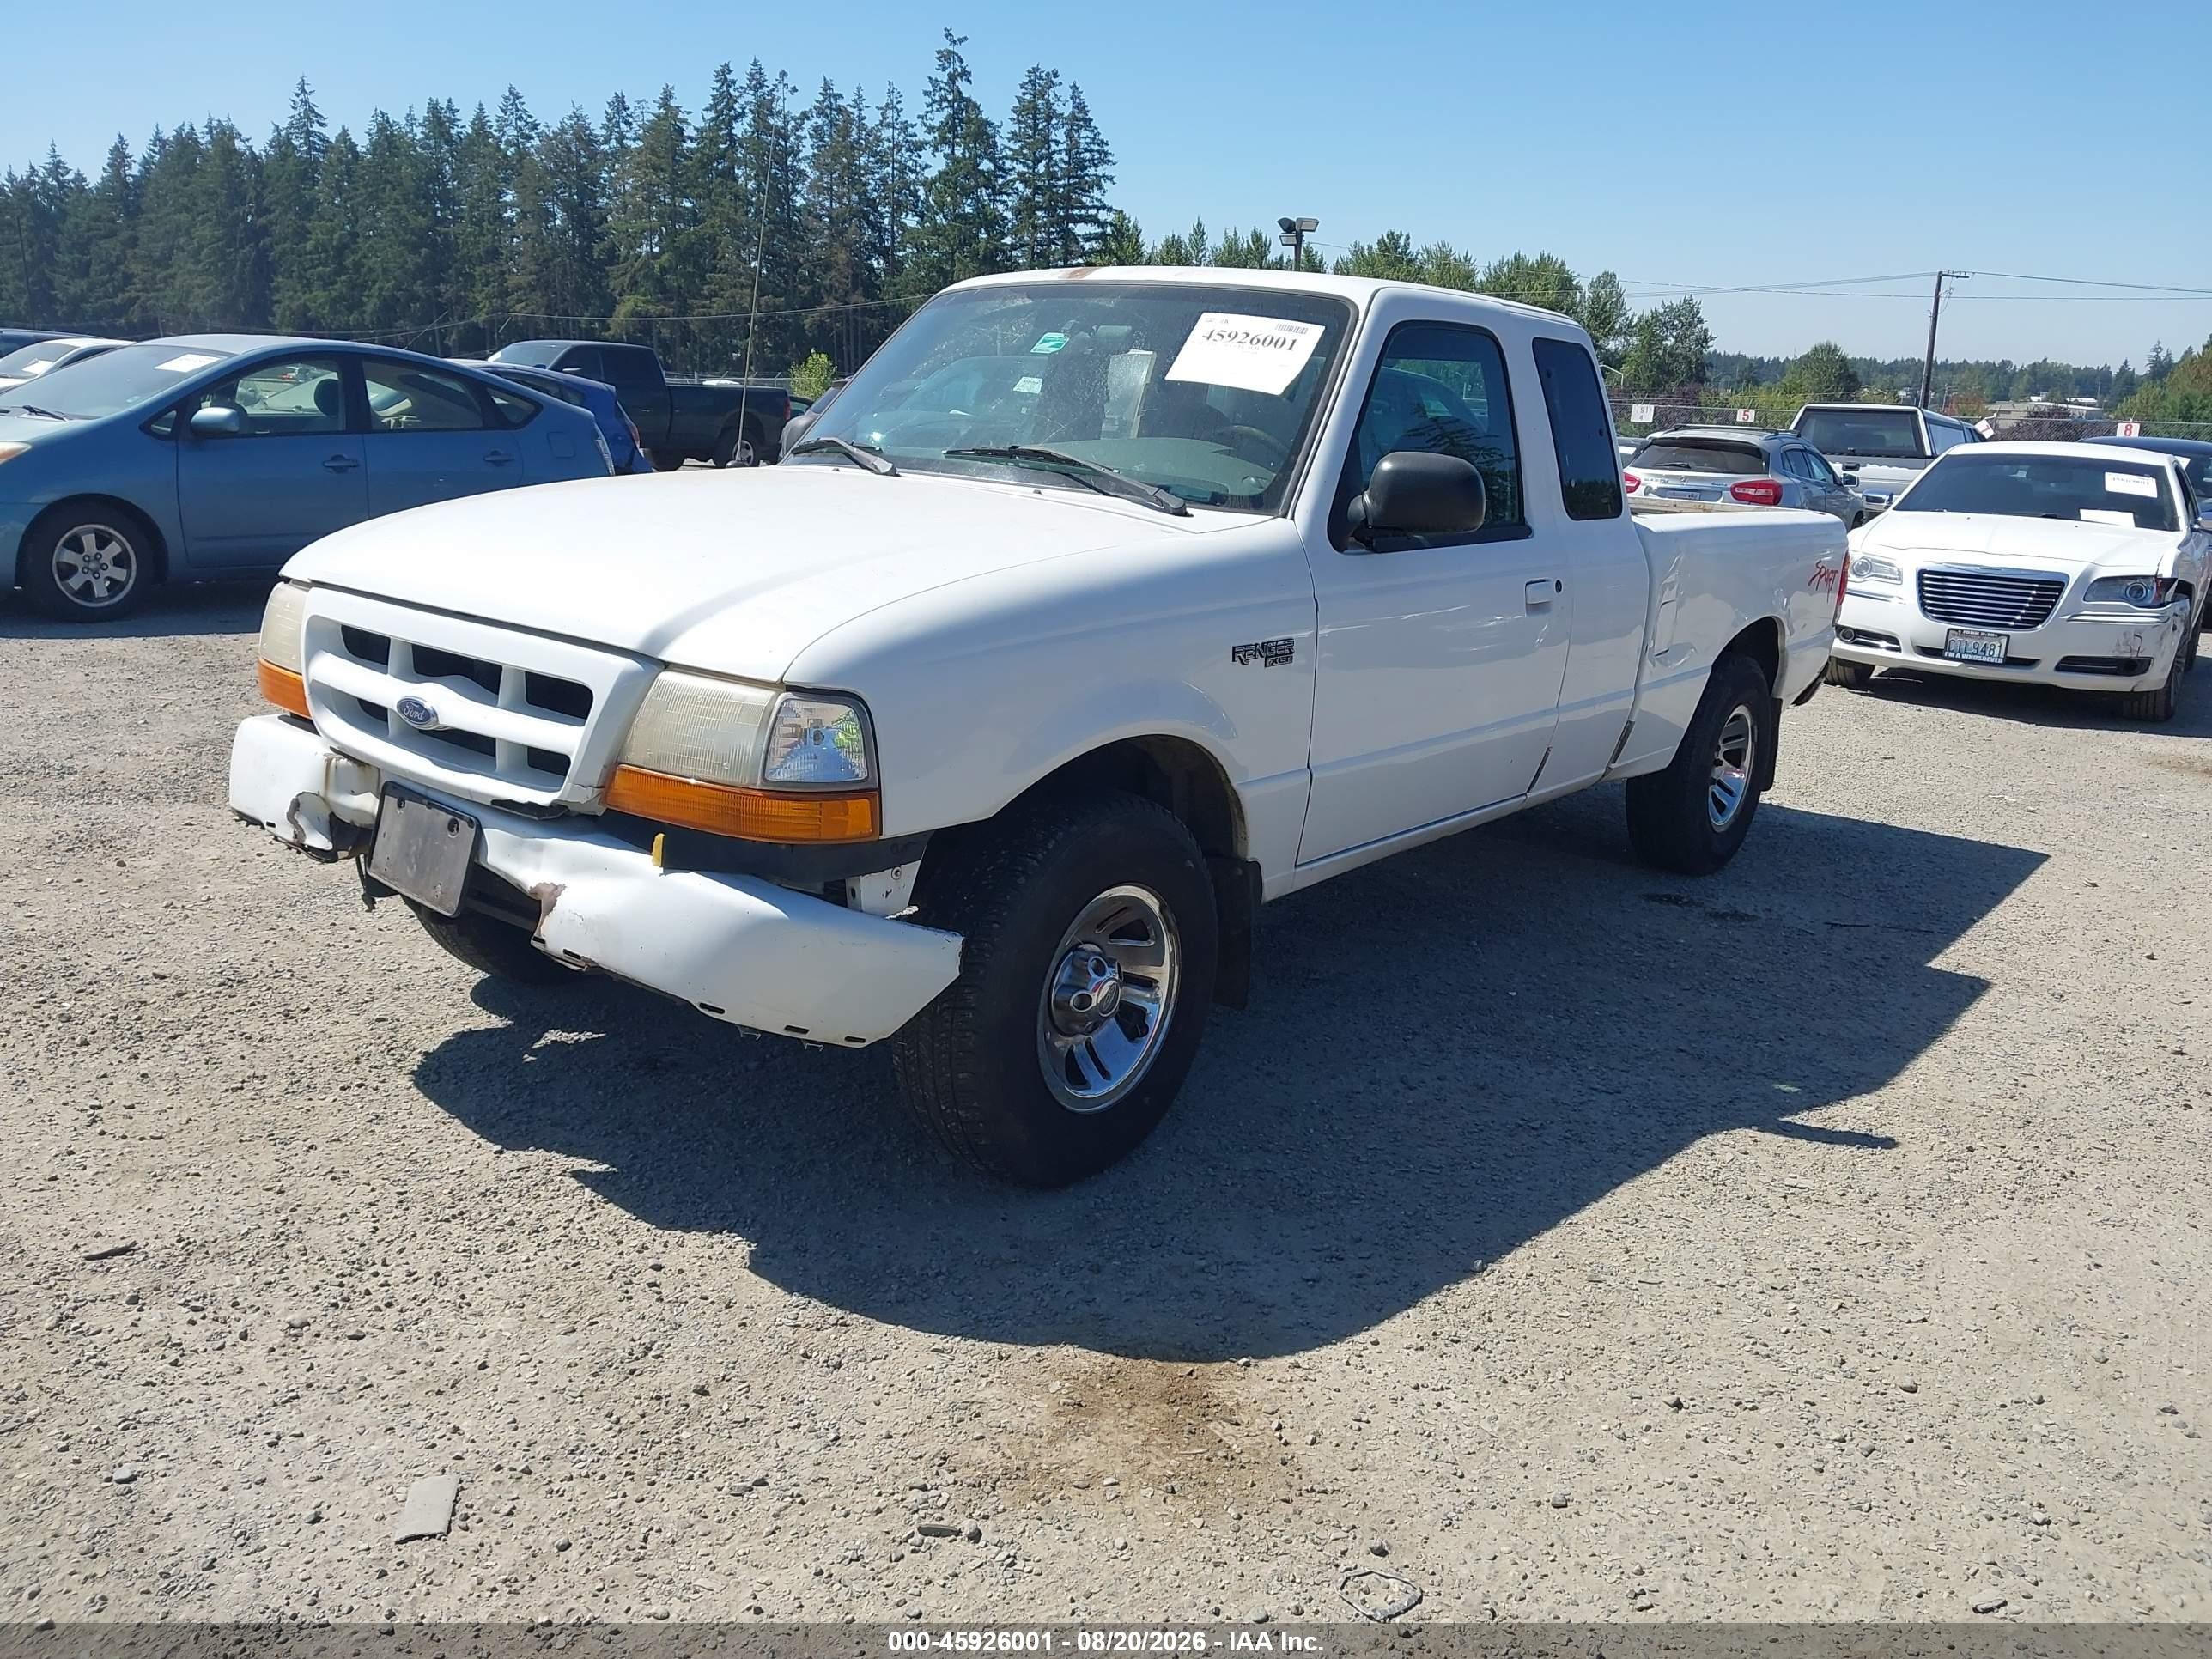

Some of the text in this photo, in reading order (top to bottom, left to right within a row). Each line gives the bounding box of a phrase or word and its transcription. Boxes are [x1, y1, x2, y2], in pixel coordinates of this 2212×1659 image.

[1201, 328, 1299, 352] 45926001
[1741, 410, 1750, 422] 5
[2124, 423, 2133, 436] 8
[1231, 638, 1295, 665] RANGER
[1948, 638, 2003, 658] CTL9481
[1267, 656, 1292, 666] XLT
[404, 701, 425, 721] Ford
